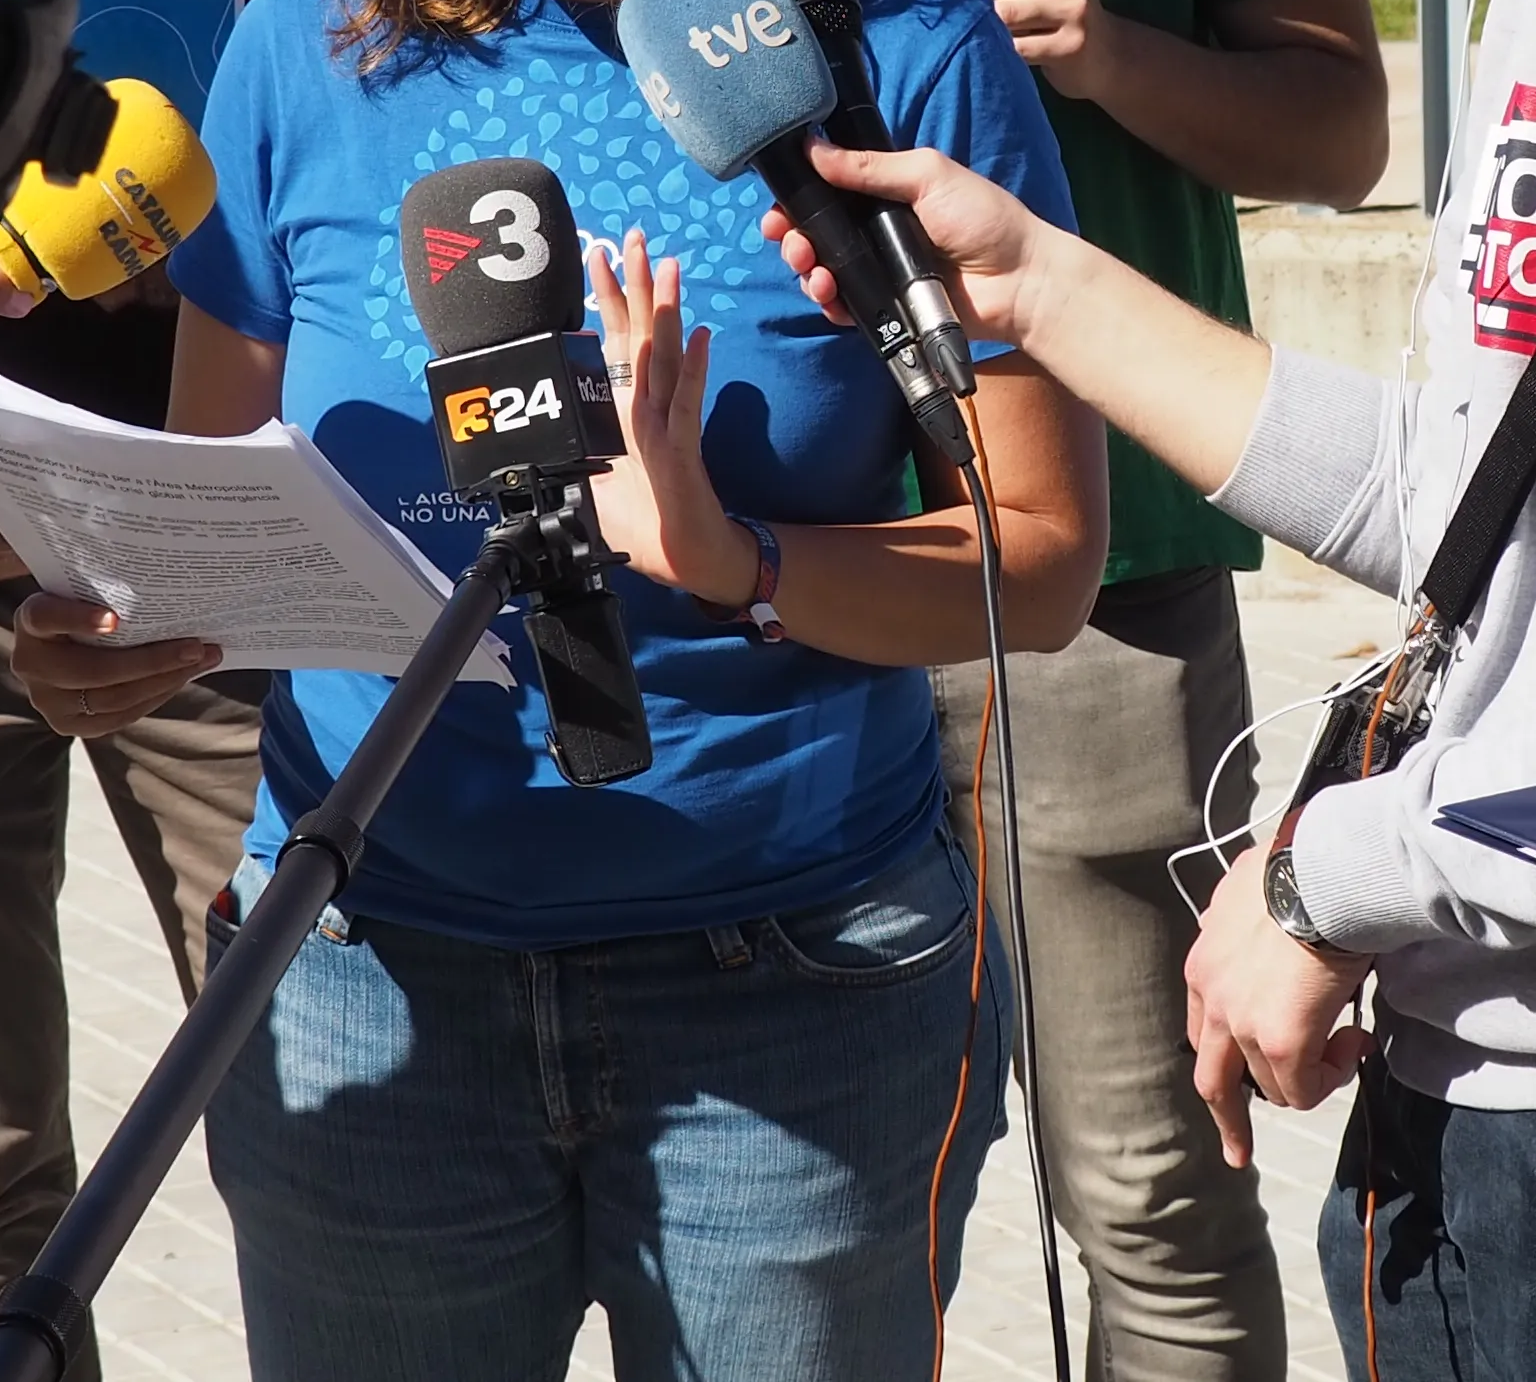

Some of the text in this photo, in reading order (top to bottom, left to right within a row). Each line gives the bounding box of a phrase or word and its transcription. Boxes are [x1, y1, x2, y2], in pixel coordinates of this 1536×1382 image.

[688, 0, 792, 68] tve
[469, 189, 551, 282] 3
[576, 375, 613, 403] tv3.cat
[184, 481, 273, 495] Metropolitana
[400, 506, 491, 523] NO UNA
